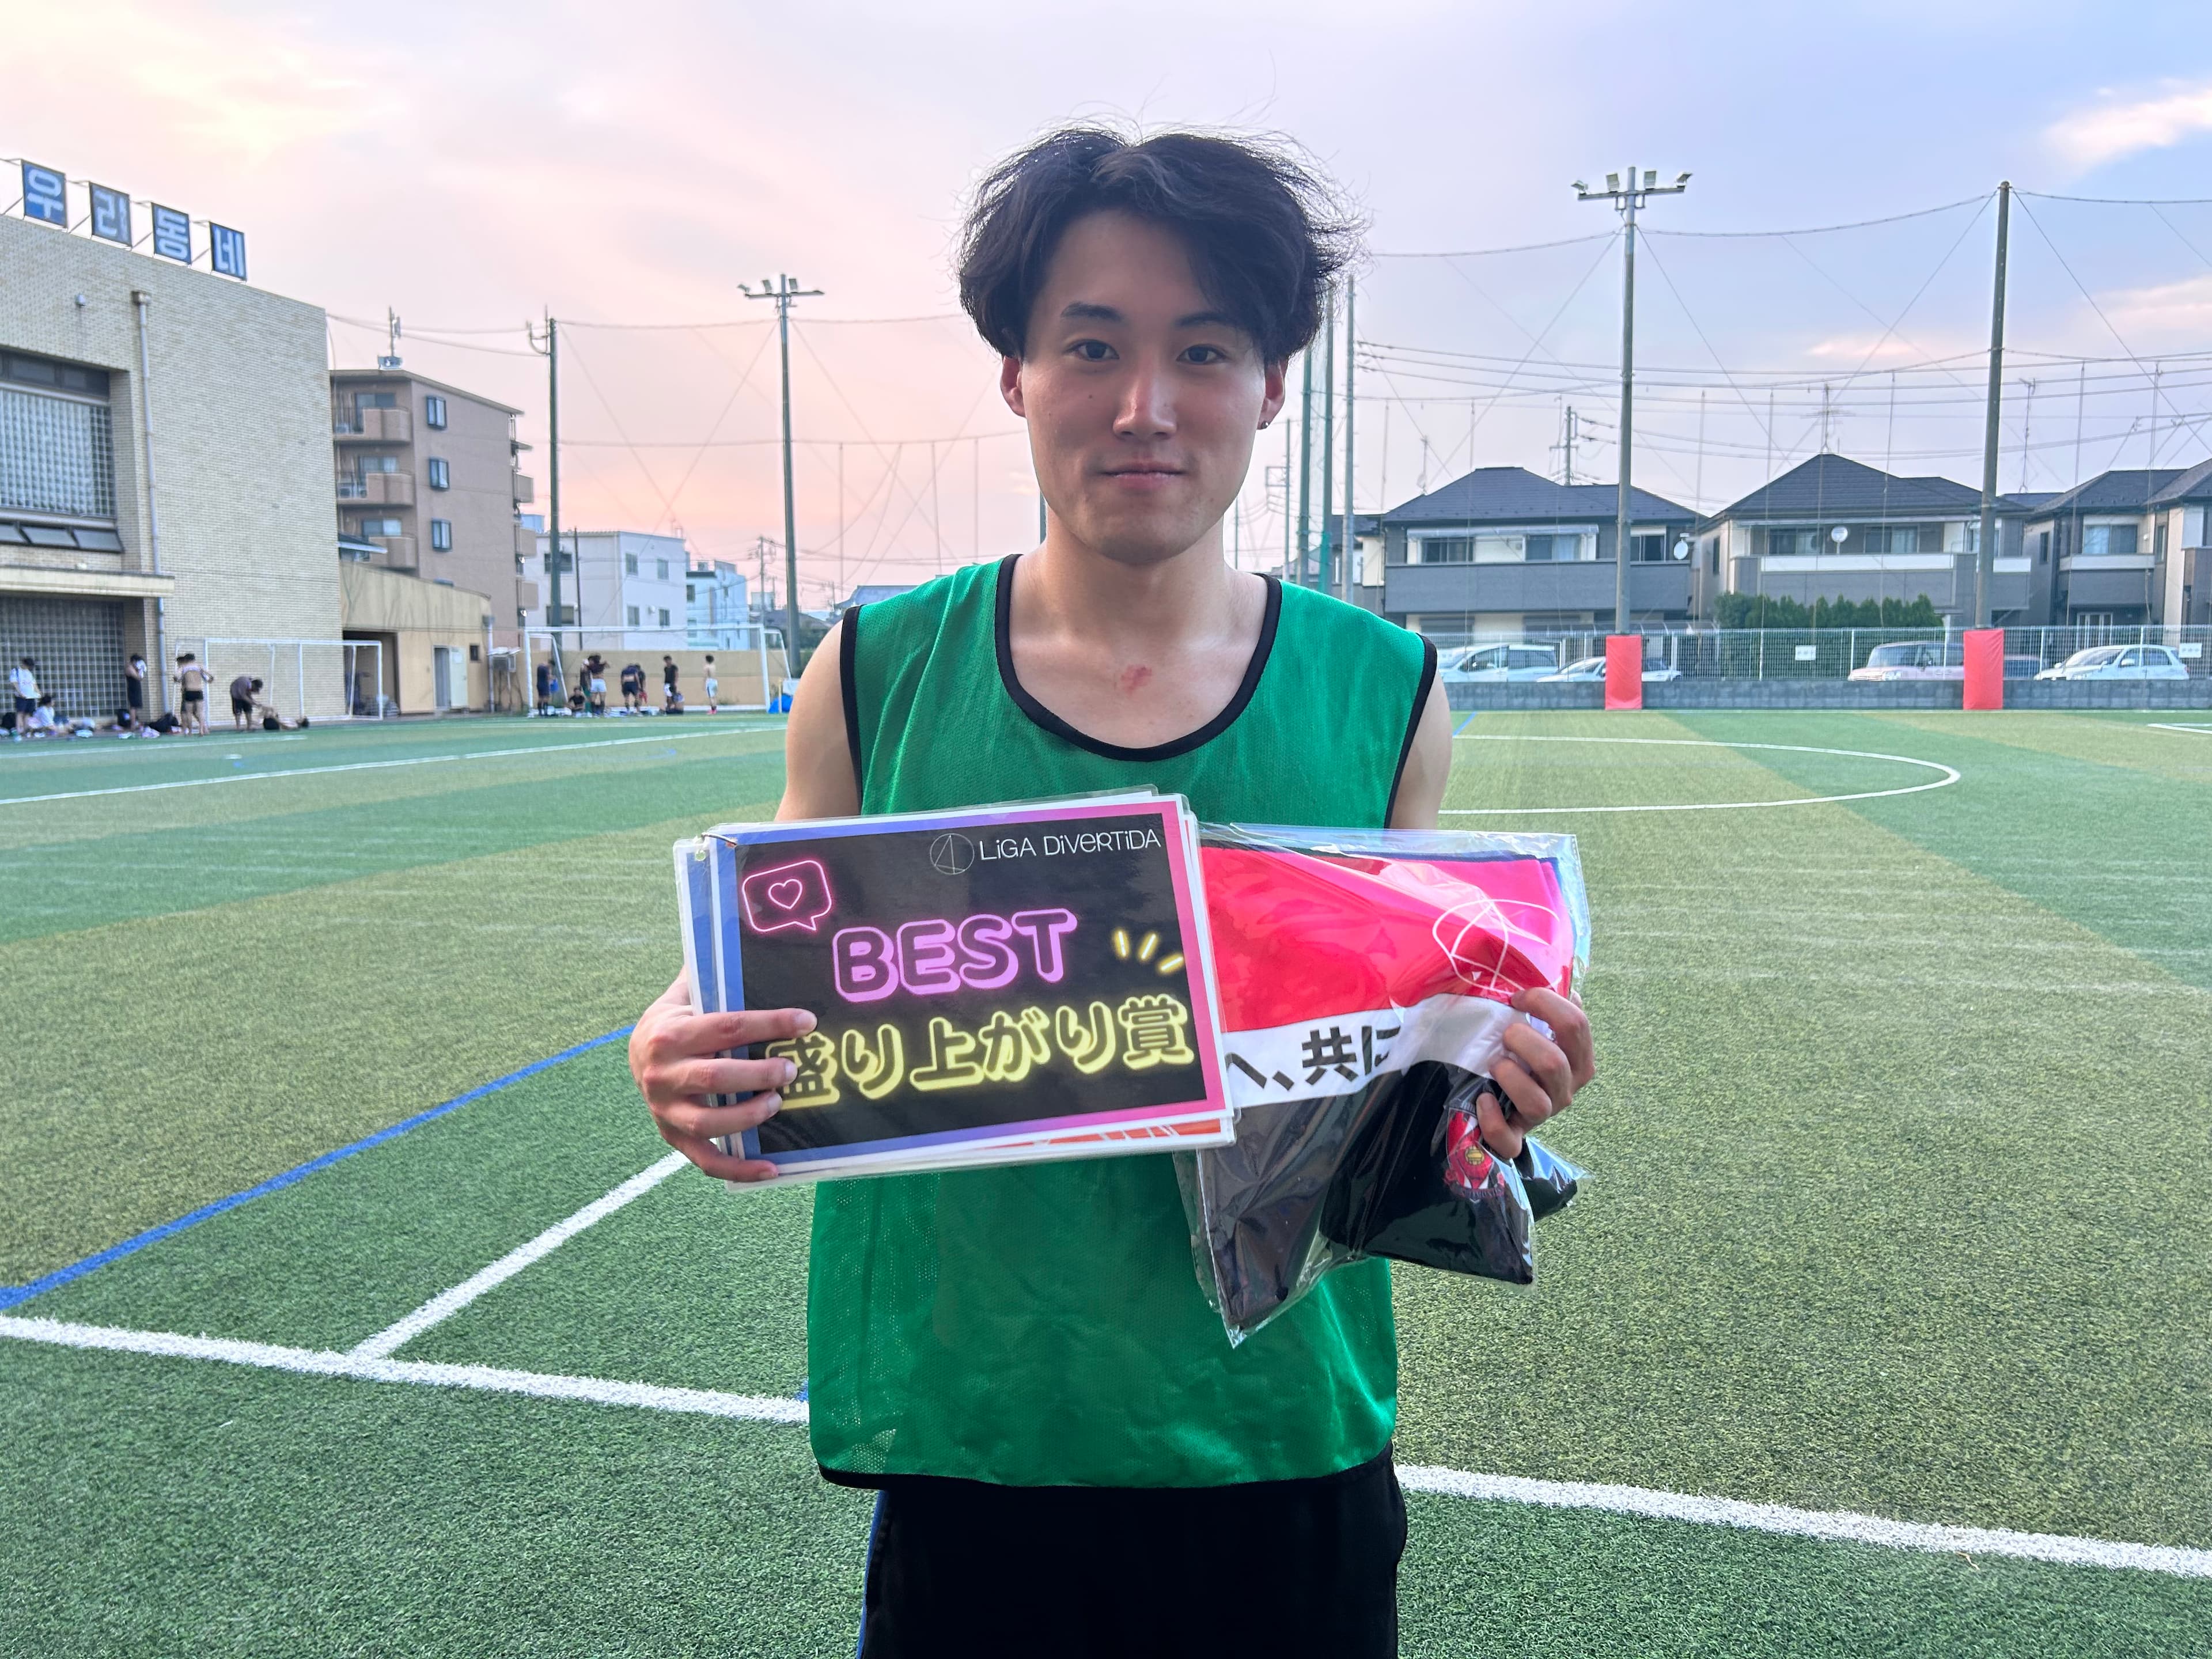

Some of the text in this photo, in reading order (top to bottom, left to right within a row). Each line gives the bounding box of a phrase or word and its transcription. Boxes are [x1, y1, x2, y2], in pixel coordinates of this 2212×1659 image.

[27, 169, 244, 277] 우리동네
[832, 908, 1078, 1003] BEST
[766, 994, 1194, 1111] 盛り上がり賞
